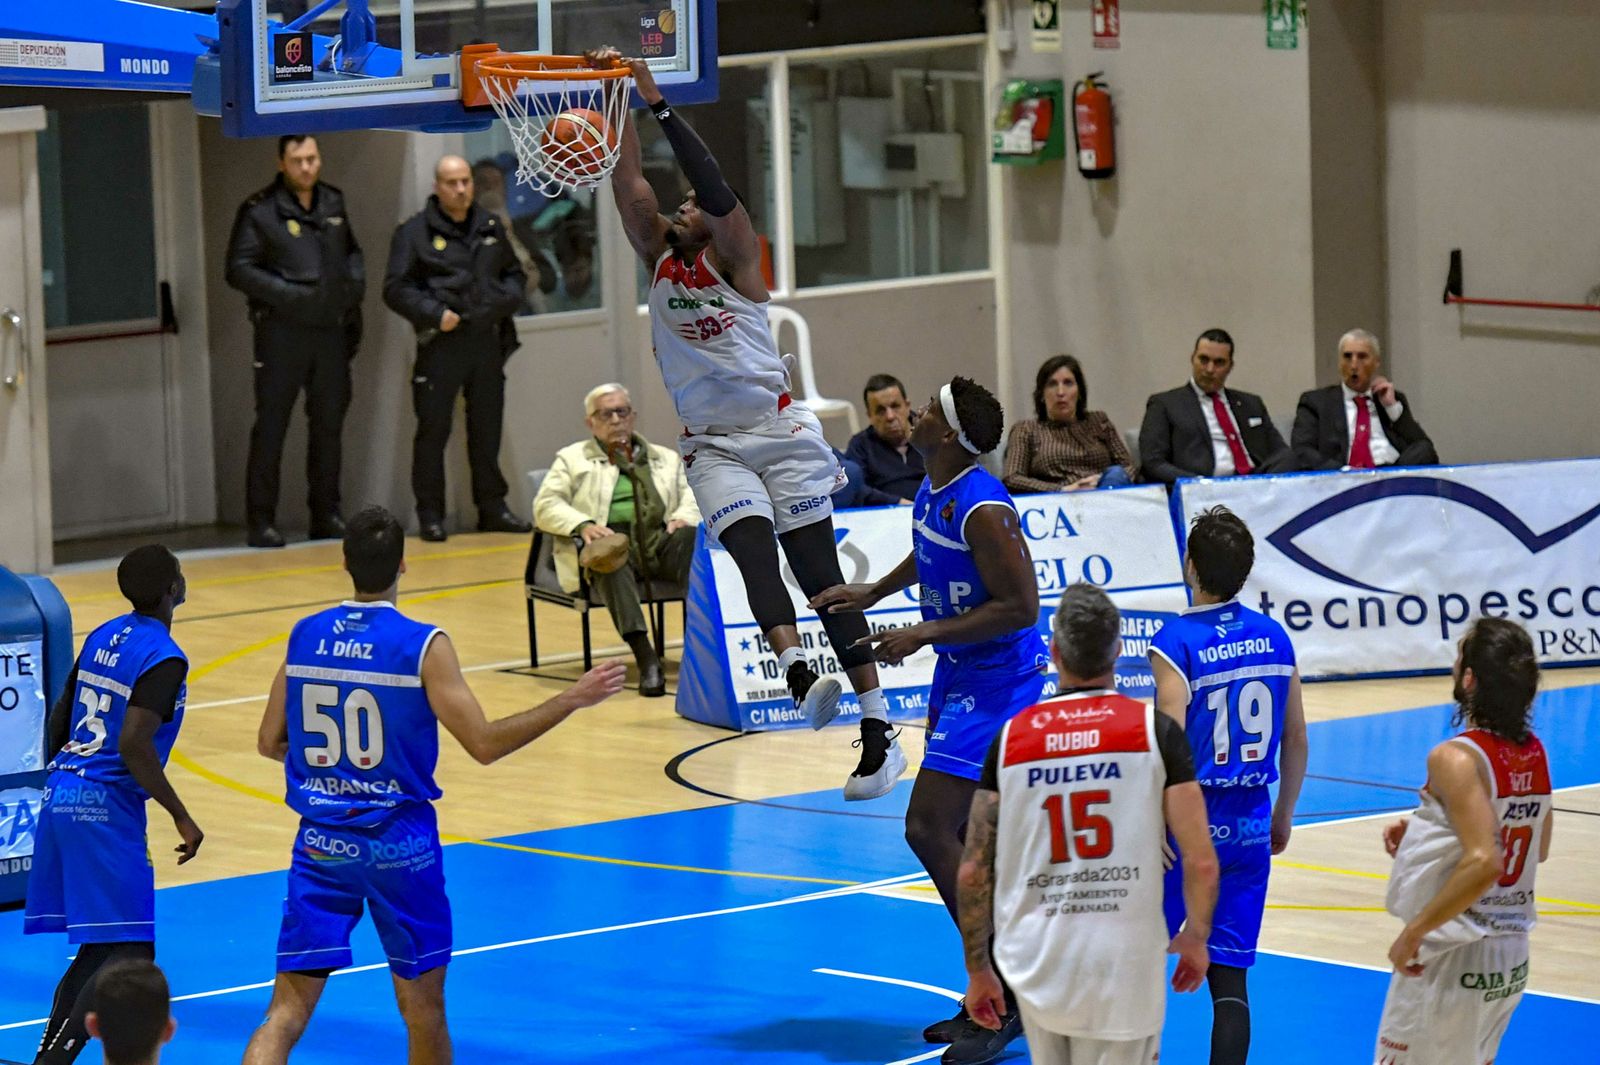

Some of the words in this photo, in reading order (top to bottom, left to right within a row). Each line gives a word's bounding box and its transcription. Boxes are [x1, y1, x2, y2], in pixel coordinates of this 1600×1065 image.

[20, 44, 66, 56] DEPUTACIÓN
[641, 33, 663, 45] LEB
[641, 45, 662, 55] ORO
[120, 58, 170, 75] MONDO
[695, 315, 723, 341] 33
[711, 499, 754, 523] BERNER
[316, 639, 328, 655] J.
[333, 638, 373, 660] DÍAZ
[1198, 637, 1275, 664] NOGUEROL
[60, 687, 112, 757] 25
[302, 683, 384, 770] 50
[750, 709, 765, 725] C/
[1207, 680, 1273, 766] 19
[1045, 729, 1100, 753] RUBIO
[1028, 762, 1122, 788] PULEVA
[1041, 789, 1114, 865] 15
[304, 828, 360, 857] Grupo
[1061, 902, 1120, 915] GRANADA
[1460, 972, 1505, 990] CAJA
